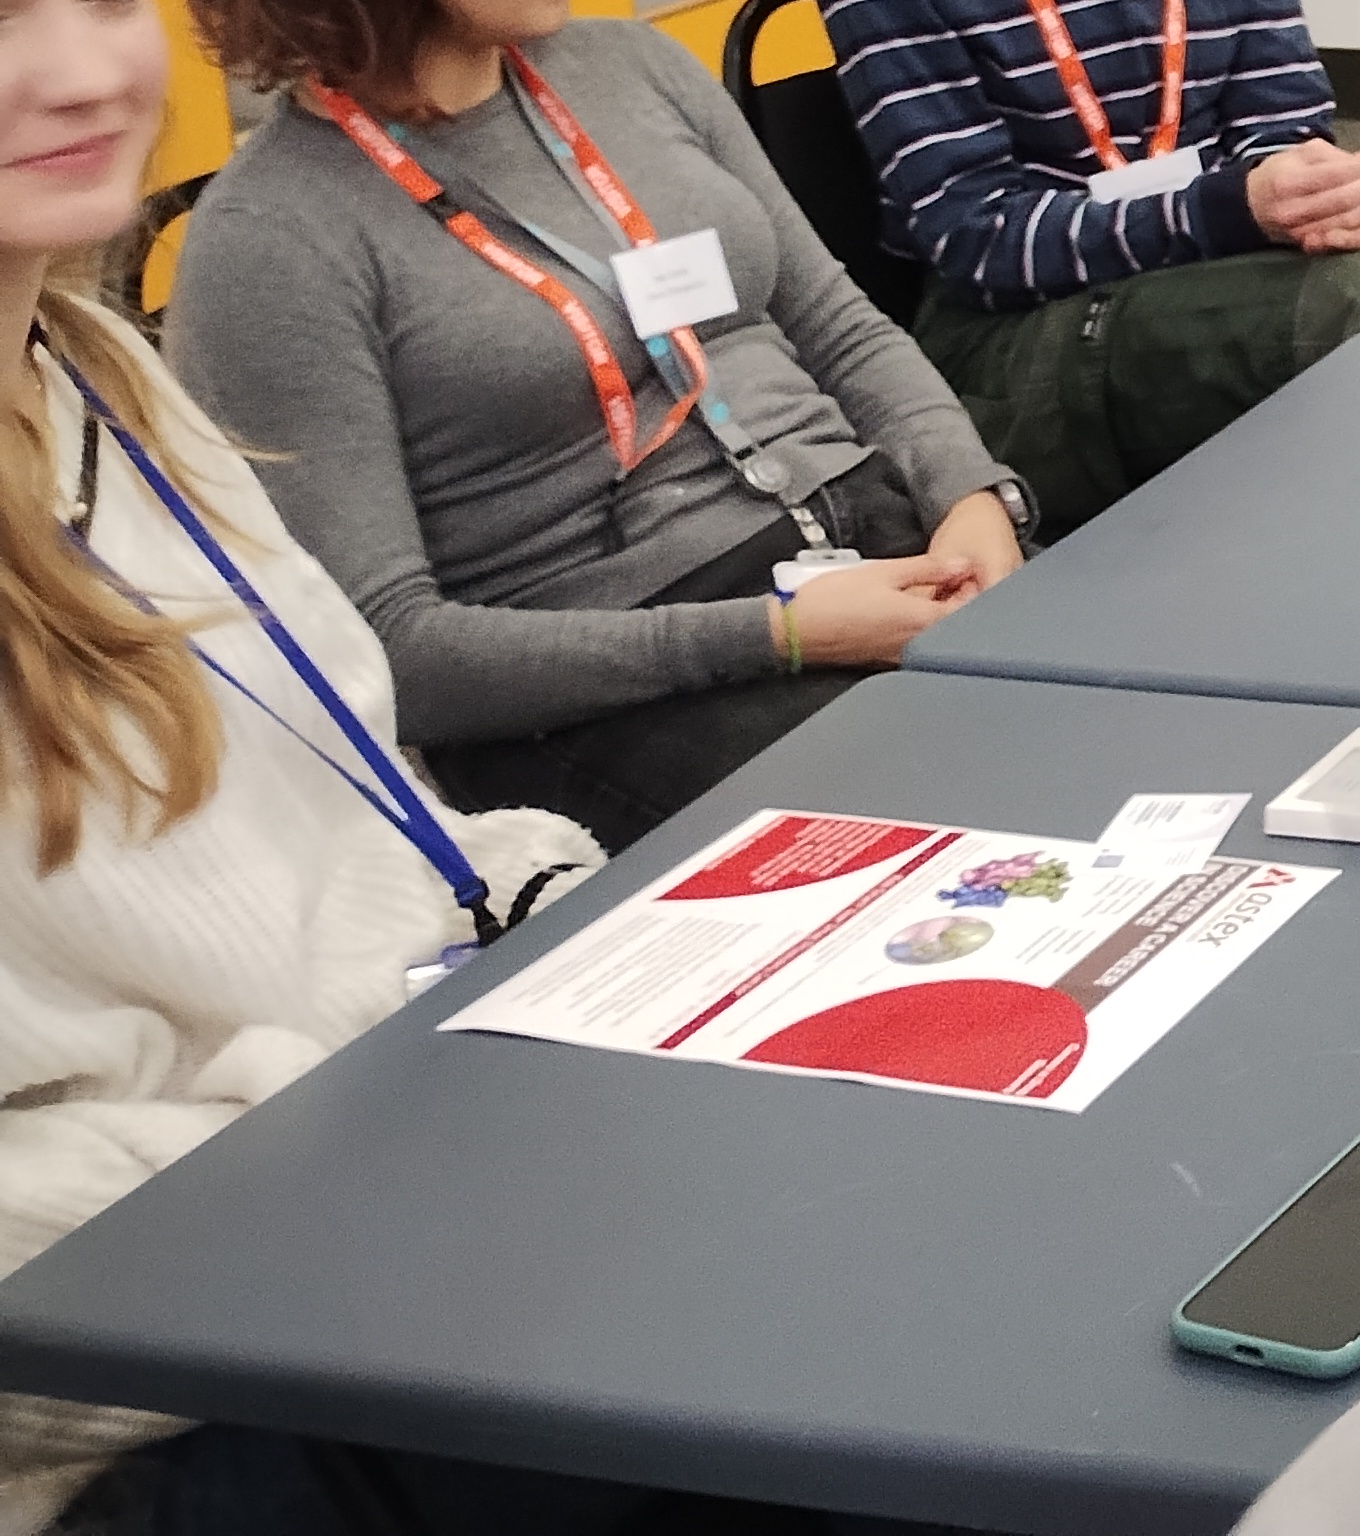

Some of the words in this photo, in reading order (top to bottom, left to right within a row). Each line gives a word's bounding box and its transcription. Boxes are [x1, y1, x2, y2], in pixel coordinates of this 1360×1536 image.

[1175, 864, 1250, 925] DISCOVER
[1198, 892, 1273, 948] astex
[1092, 933, 1168, 987] CAREER
